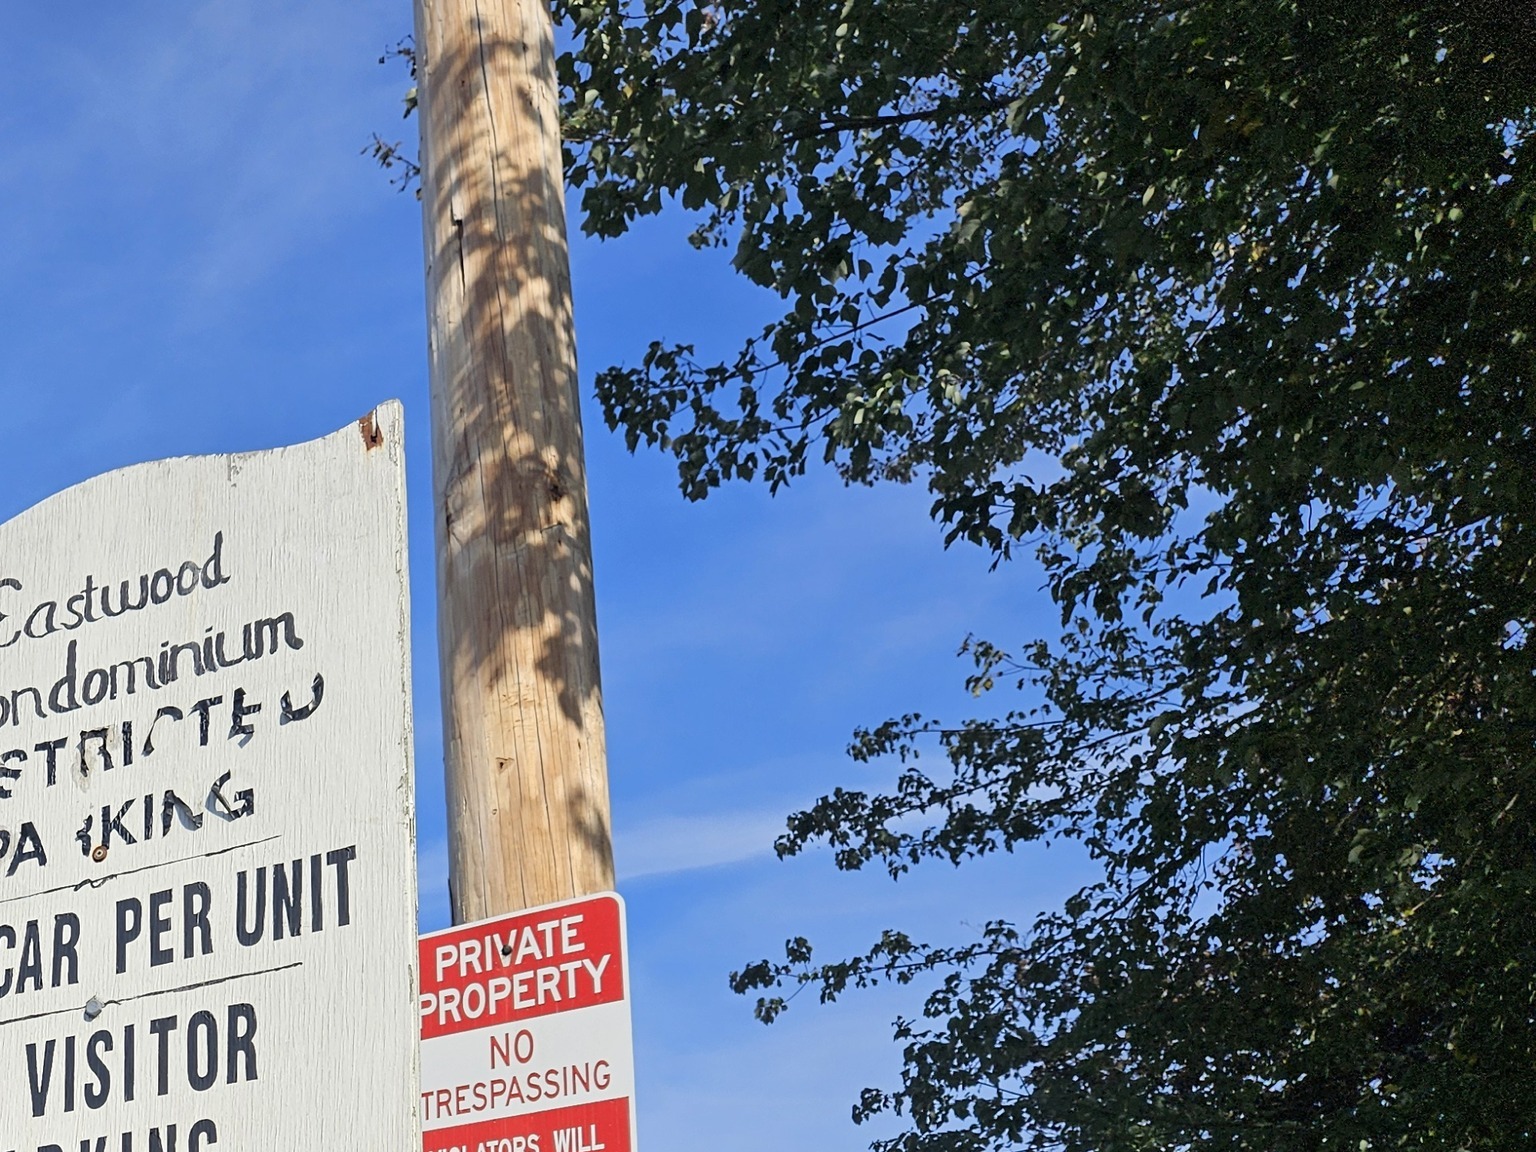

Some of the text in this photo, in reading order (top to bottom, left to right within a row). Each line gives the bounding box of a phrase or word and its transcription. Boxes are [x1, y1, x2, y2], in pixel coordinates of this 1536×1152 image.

[114, 881, 214, 975] PER
[235, 845, 357, 947] UNIT
[435, 914, 585, 982] PRIVATE
[420, 954, 611, 1028] PROPERTY
[25, 1002, 259, 1118] VISITOR
[489, 1029, 534, 1070] NO
[421, 1060, 611, 1121] TRESPASSING
